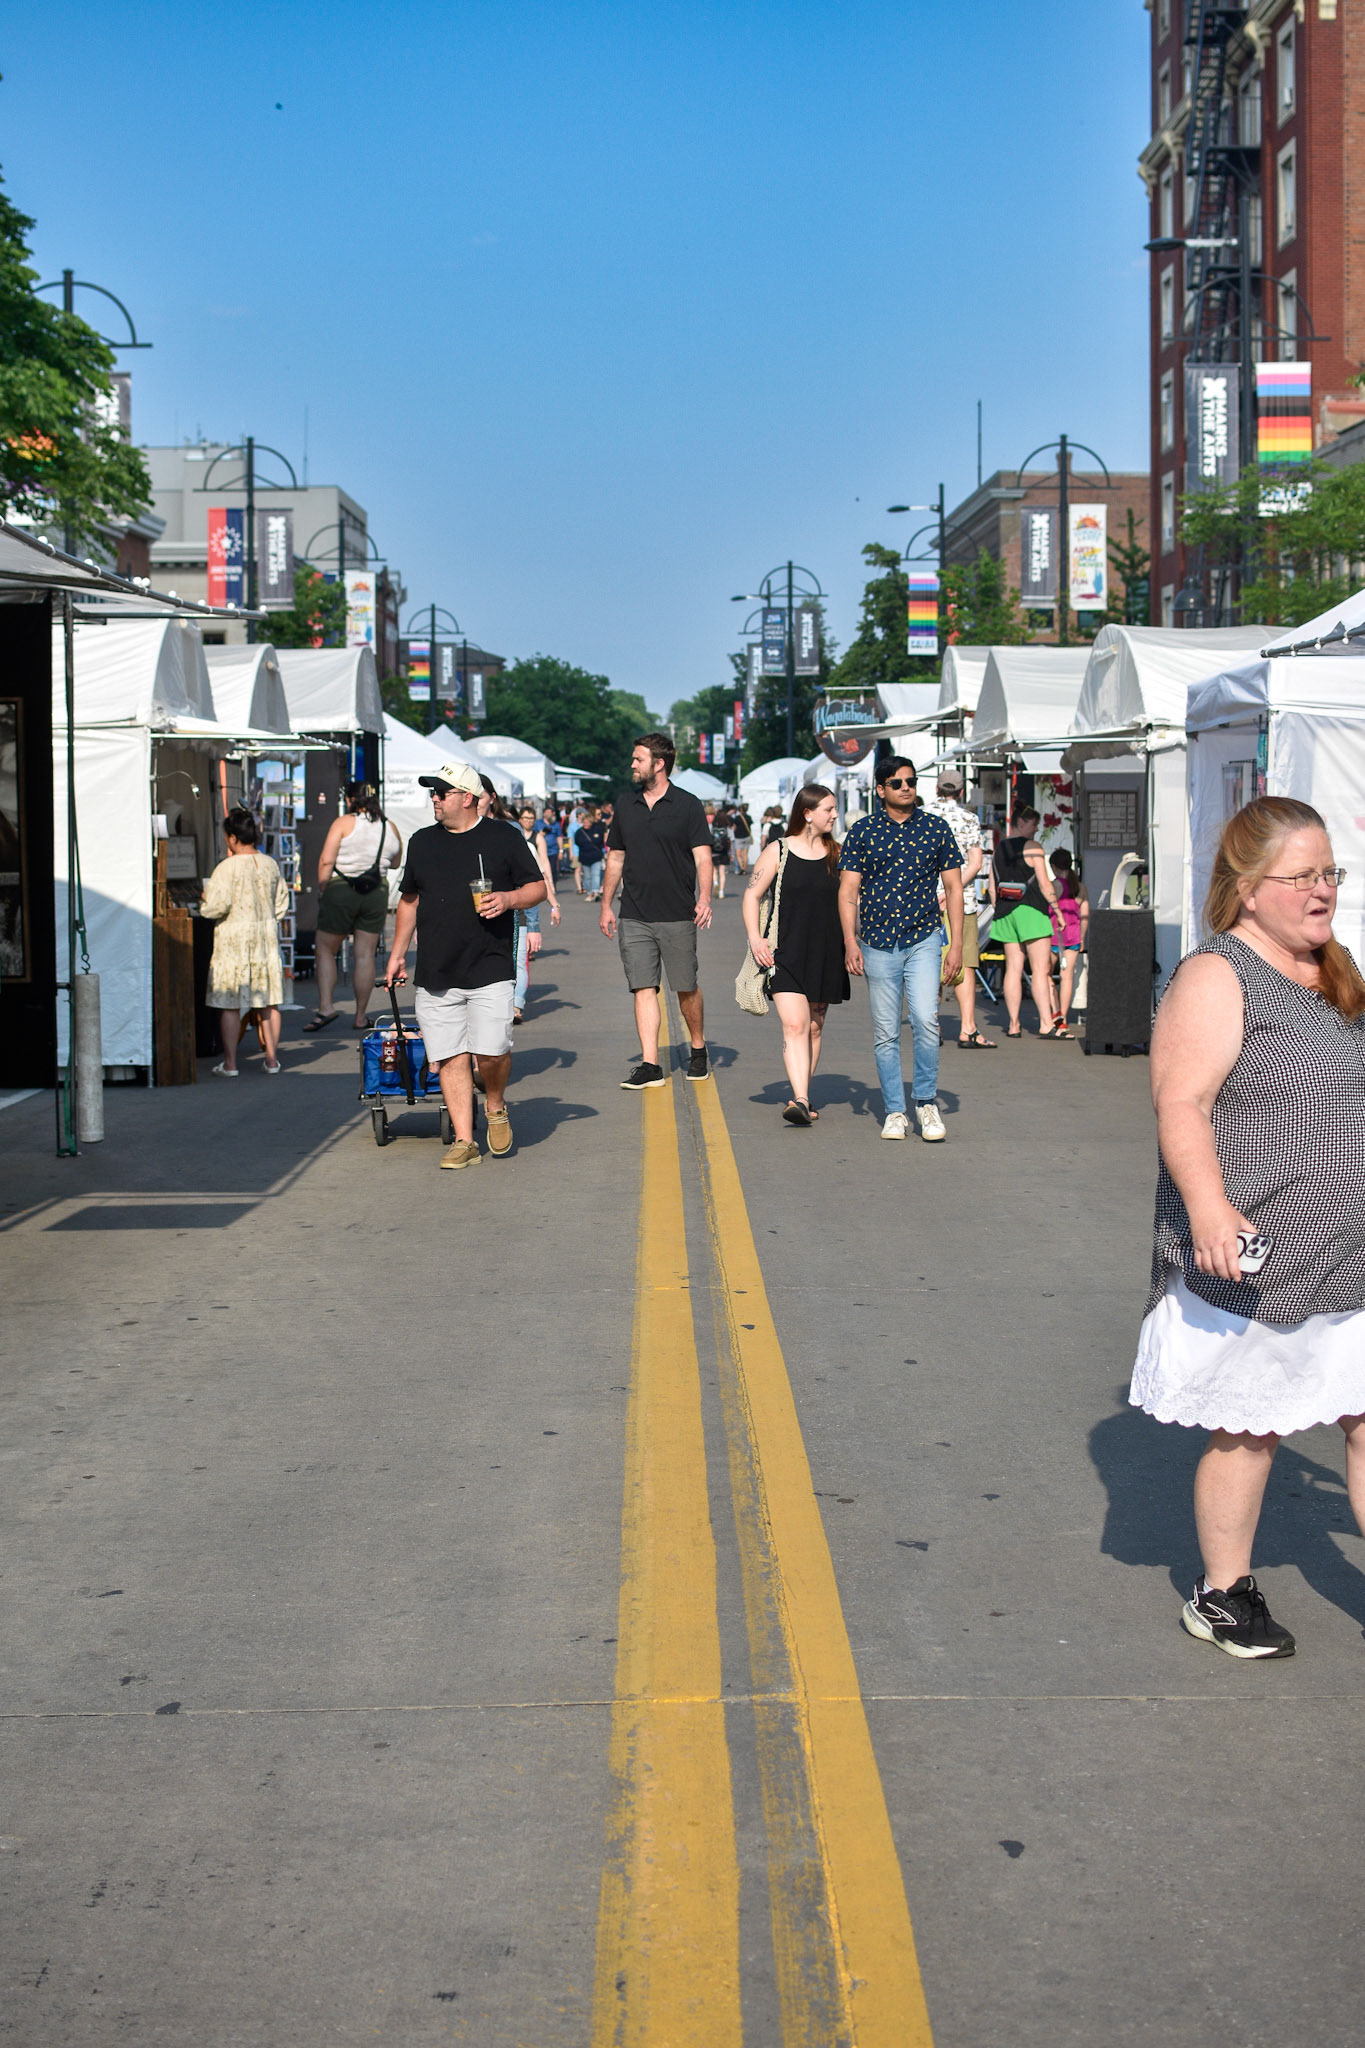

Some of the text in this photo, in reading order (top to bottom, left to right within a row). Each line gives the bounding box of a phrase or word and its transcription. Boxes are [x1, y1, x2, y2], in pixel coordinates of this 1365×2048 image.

[1203, 399, 1216, 476] THE ARTS
[1215, 399, 1227, 457] MARKS
[1031, 529, 1041, 582] THE ARTS
[1040, 529, 1050, 569] MARKS
